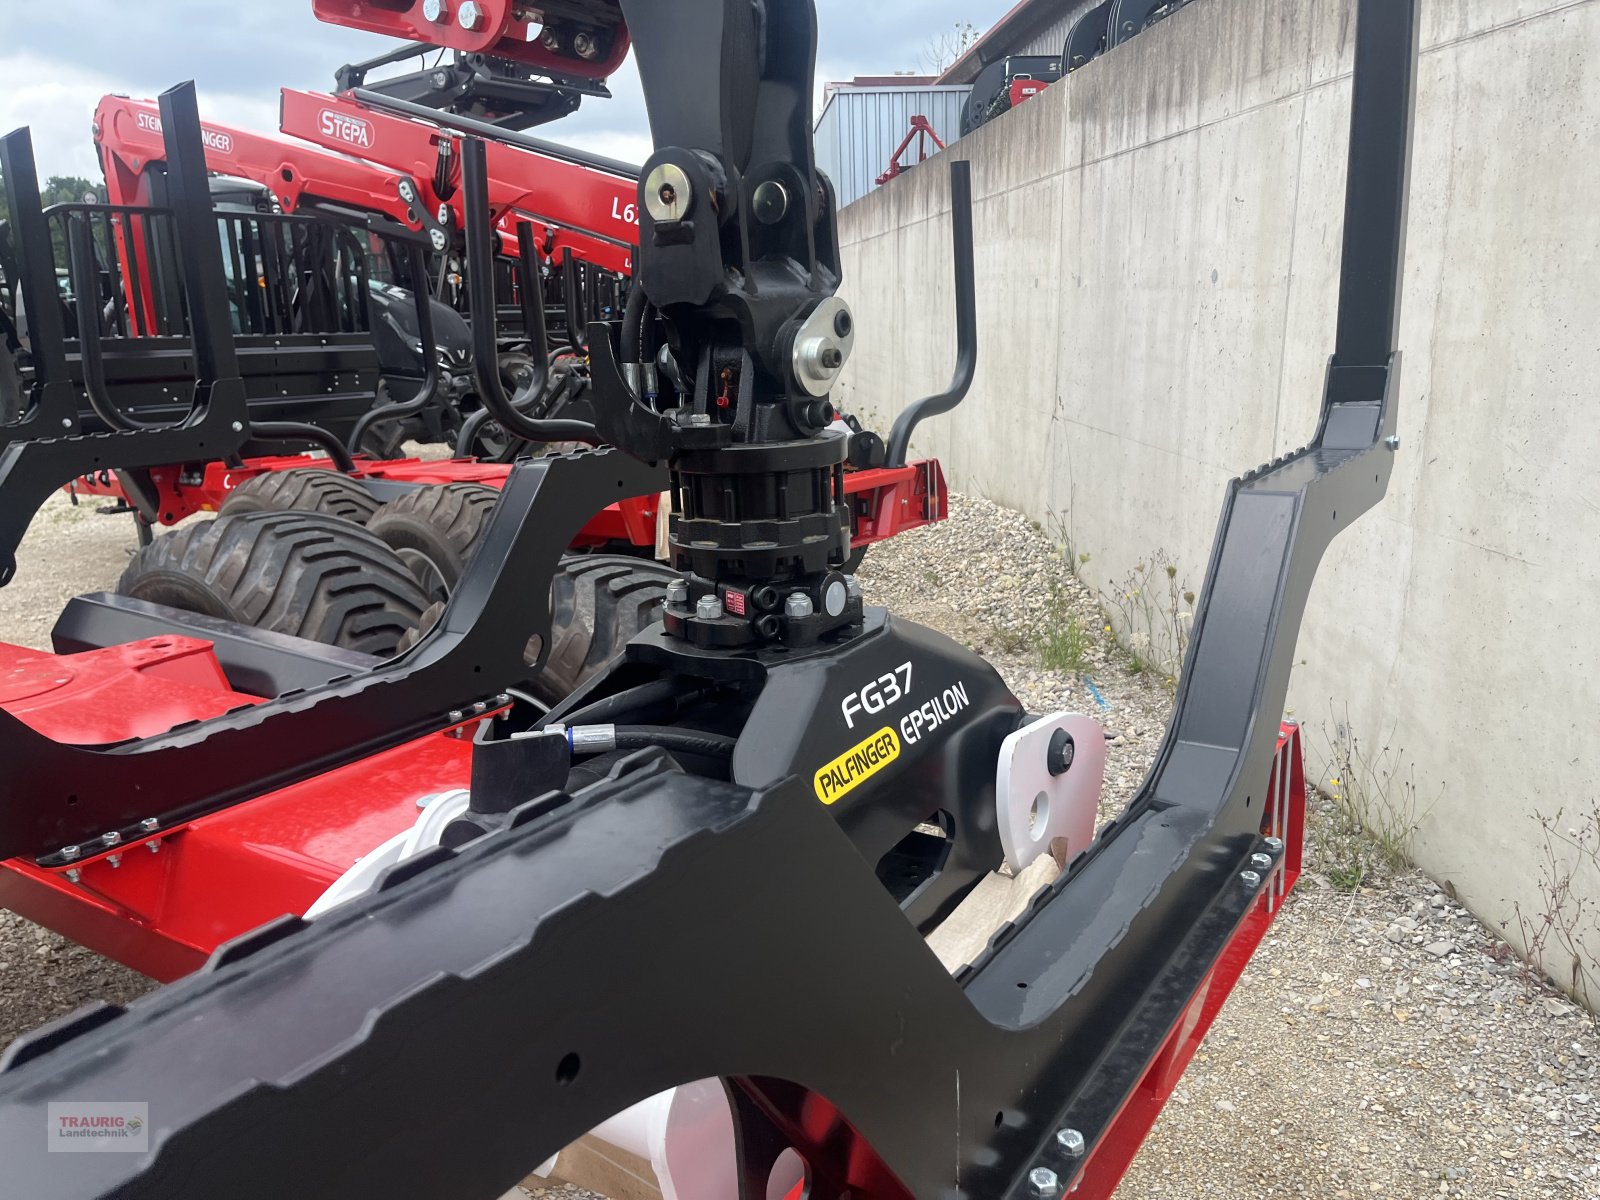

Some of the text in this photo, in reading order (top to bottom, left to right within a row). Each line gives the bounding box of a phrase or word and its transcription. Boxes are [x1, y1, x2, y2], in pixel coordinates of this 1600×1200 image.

[138, 113, 230, 151] STEIN NGER
[321, 110, 369, 147] STEPA
[841, 660, 913, 729] FG37
[818, 680, 970, 799] PALFINGER EPSILON
